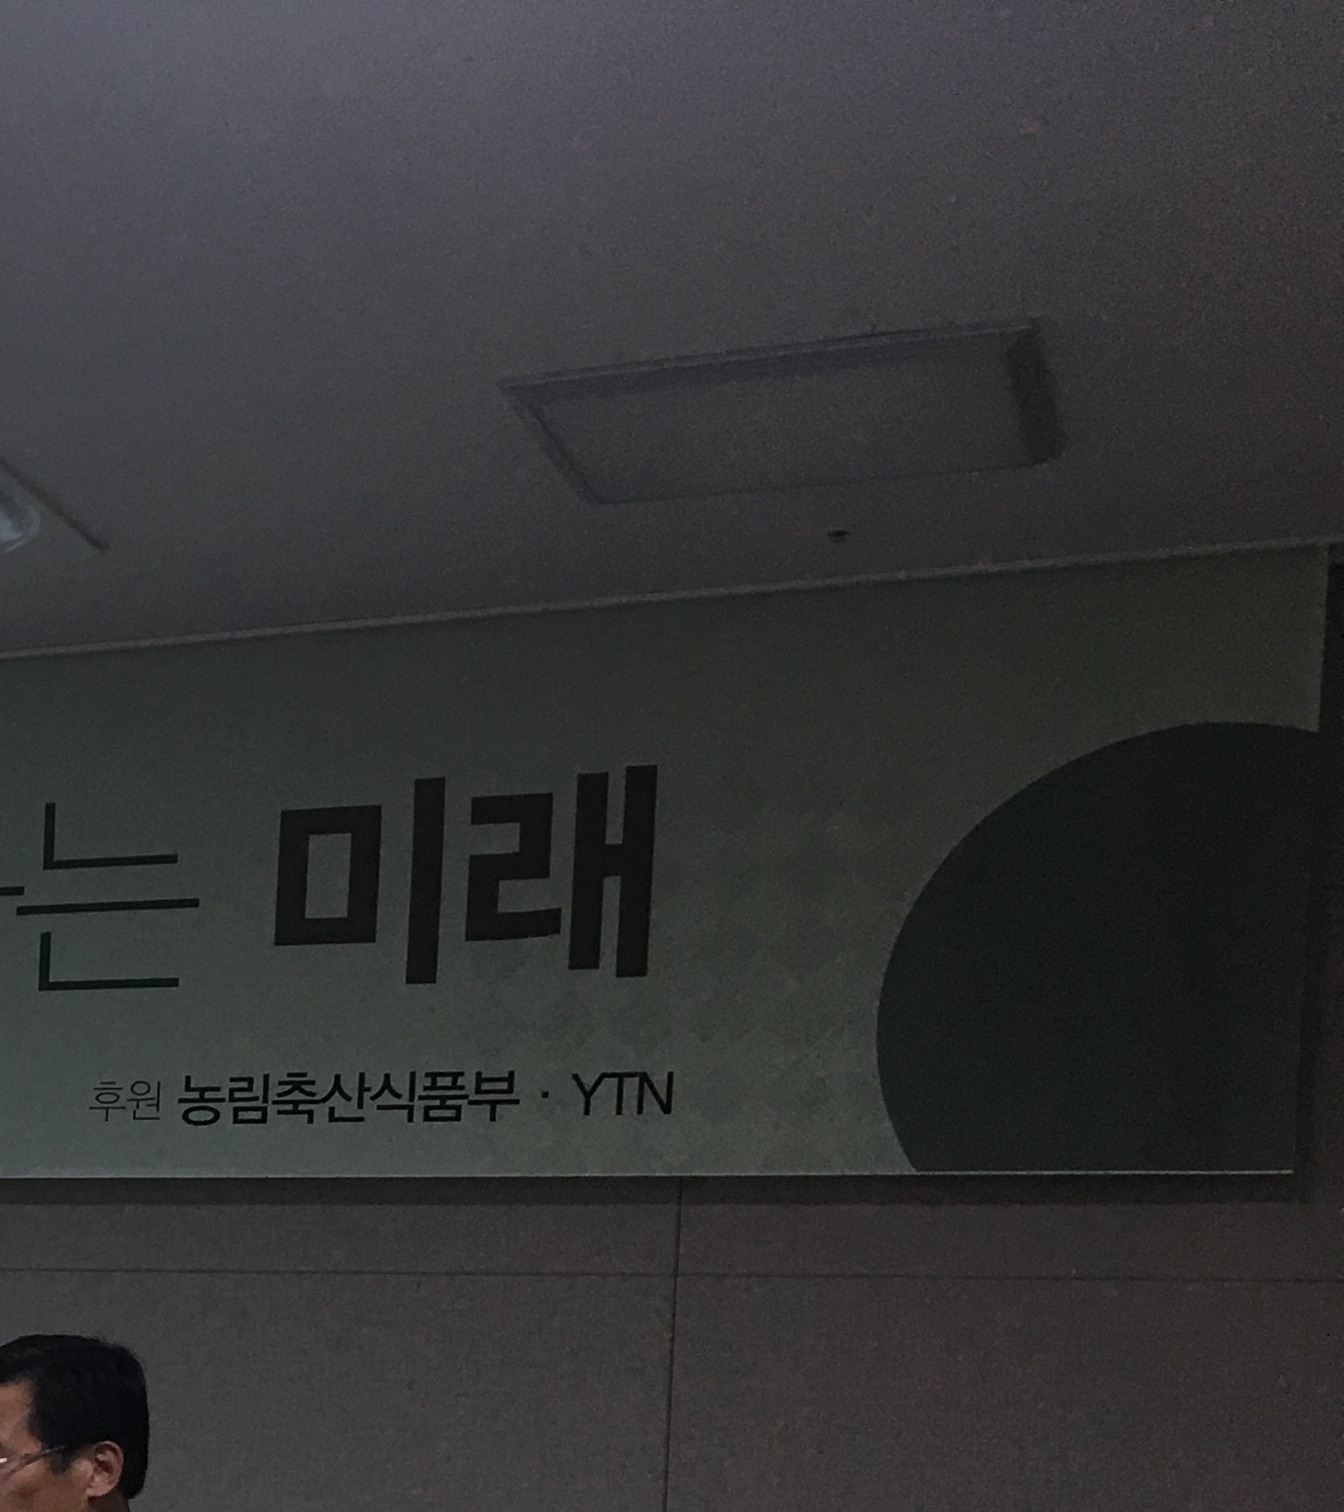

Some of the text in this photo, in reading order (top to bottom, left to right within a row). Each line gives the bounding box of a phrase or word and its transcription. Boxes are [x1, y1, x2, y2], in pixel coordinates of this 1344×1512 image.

[274, 765, 658, 984] 미래
[88, 1078, 162, 1123] 후원
[177, 1070, 520, 1126] 농림축산식품부
[570, 1070, 676, 1117] YTN
